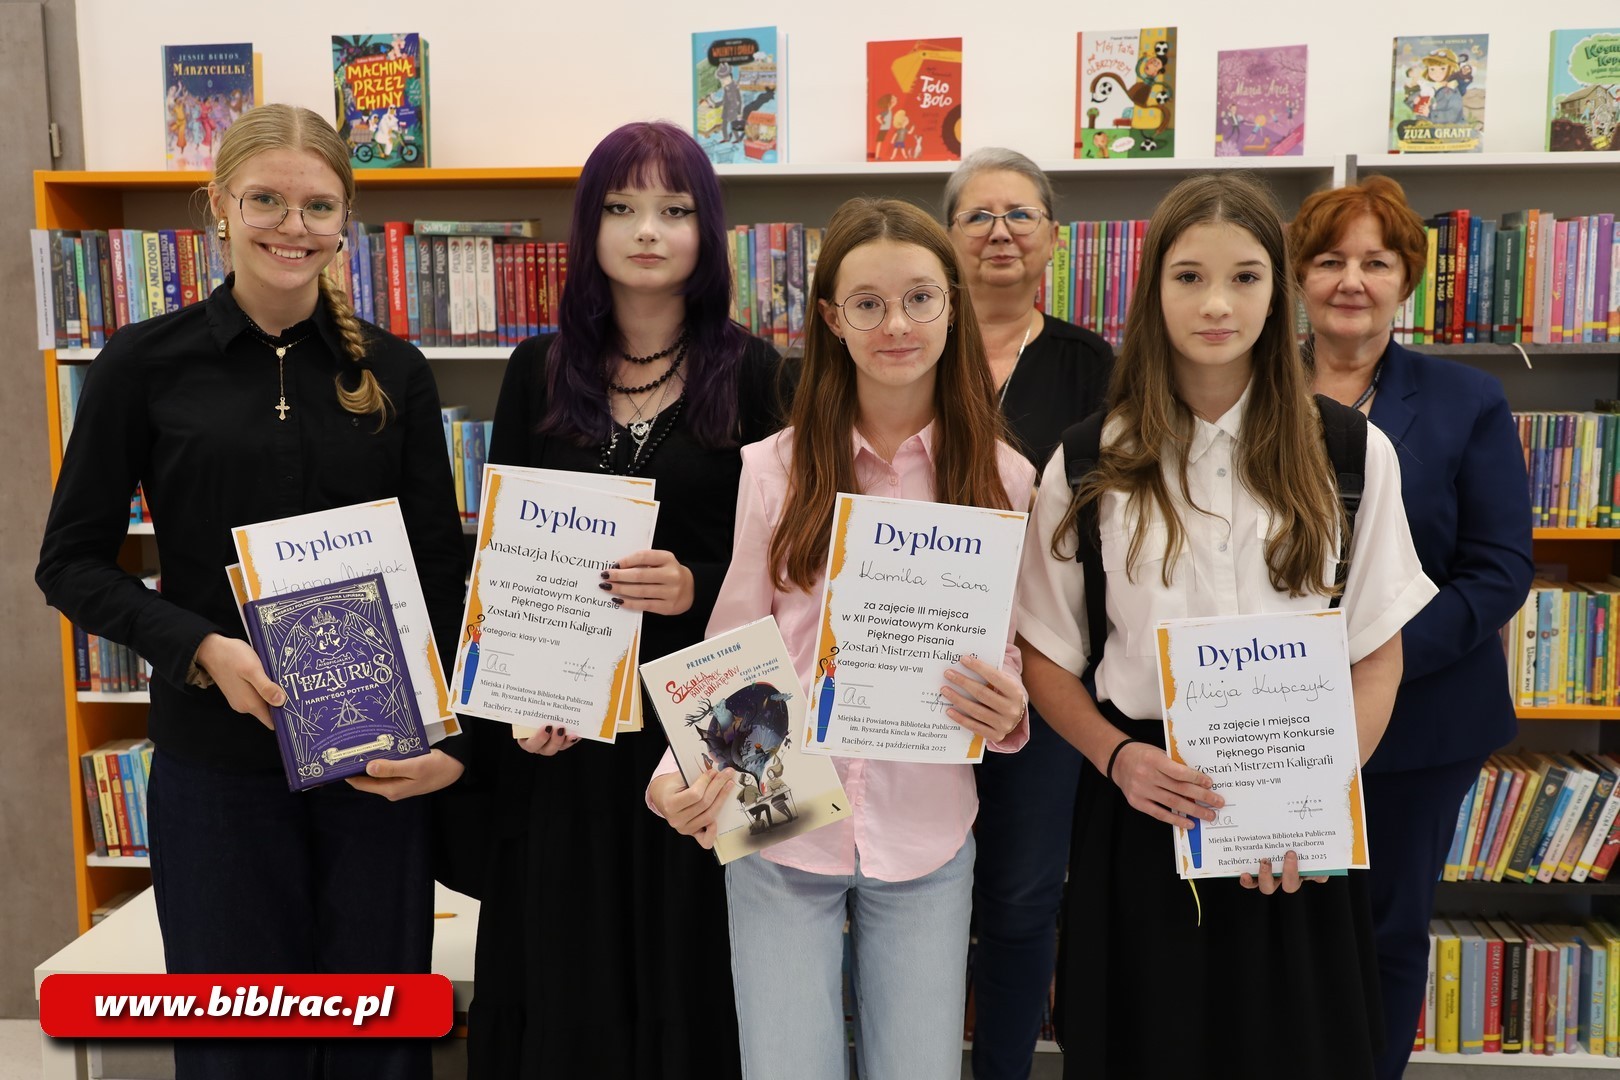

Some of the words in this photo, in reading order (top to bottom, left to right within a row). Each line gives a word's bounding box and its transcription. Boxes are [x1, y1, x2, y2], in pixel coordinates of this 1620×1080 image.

[173, 63, 245, 77] MARZYCIELKI
[348, 59, 414, 79] MACHINĄ
[354, 76, 404, 96] PRZEZ
[357, 91, 402, 110] CHINY
[1403, 129, 1431, 140] ZUZA
[1434, 127, 1473, 139] GRANT
[146, 238, 161, 289] URODZINY
[160, 235, 172, 282] KONTROLER
[520, 499, 616, 536] Dyplom
[275, 530, 372, 562] Dyplom
[874, 522, 981, 555] Dyplom
[536, 574, 547, 582] za
[549, 577, 577, 587] udział
[499, 580, 510, 588] XII
[512, 582, 572, 600] Powiatowym
[574, 597, 621, 609] Konkursie
[511, 595, 554, 612] Pięknego
[556, 604, 590, 617] Pisania
[878, 602, 915, 614] zajęcie
[917, 606, 925, 614] III
[928, 607, 968, 619] miejsca
[487, 605, 520, 619] Zostań
[523, 611, 567, 628] Mistrzem
[569, 620, 612, 636] Kaligrafii
[853, 614, 865, 622] XII
[867, 615, 934, 630] Powiatowym
[936, 622, 986, 635] Konkursie
[482, 626, 518, 638] Kategoria:
[519, 633, 536, 643] klasy
[538, 637, 560, 646] VII-VIII
[867, 629, 914, 643] Pięknego
[917, 634, 954, 645] Pisania
[716, 642, 741, 658] STAROŃ
[842, 641, 878, 653] Zostań
[882, 644, 930, 658] Mistrzem
[1197, 637, 1306, 671] Dyplom
[837, 659, 876, 669] Kategoria:
[877, 662, 897, 672] klasy
[899, 665, 923, 673] VII-VIII
[284, 653, 392, 701] TEZAURUS
[346, 683, 380, 696] POTTERA
[480, 679, 502, 689] Miejska
[506, 684, 536, 695] Powiatowa
[537, 690, 565, 700] Biblioteka
[566, 695, 594, 706] Publiczna
[1186, 680, 1241, 711] Alicja
[501, 693, 526, 703] Ryszarda
[552, 702, 580, 713] Raciborzu
[522, 710, 564, 722] października
[565, 718, 579, 726] 2025
[837, 714, 860, 722] Miejska
[866, 717, 898, 726] Powiatowa
[900, 720, 930, 728] Biblioteka
[1223, 718, 1259, 731] zajęcie
[1262, 718, 1265, 726] I
[1268, 715, 1310, 726] miejsca
[861, 726, 889, 734] Ryszarda
[1199, 737, 1210, 745] XII
[1213, 732, 1280, 744] Powiatowym
[1283, 726, 1334, 738] Konkursie
[885, 741, 929, 750] października
[1216, 748, 1264, 759] Pięknego
[1267, 744, 1305, 754] Pisania
[1234, 761, 1284, 771] Mistrzem
[1286, 754, 1333, 769] Kaligrafii
[1256, 777, 1281, 785] VII-VIII
[1272, 831, 1303, 839] Biblioteka
[1234, 843, 1263, 852] Ryszarda
[1292, 840, 1325, 848] Raciborzu
